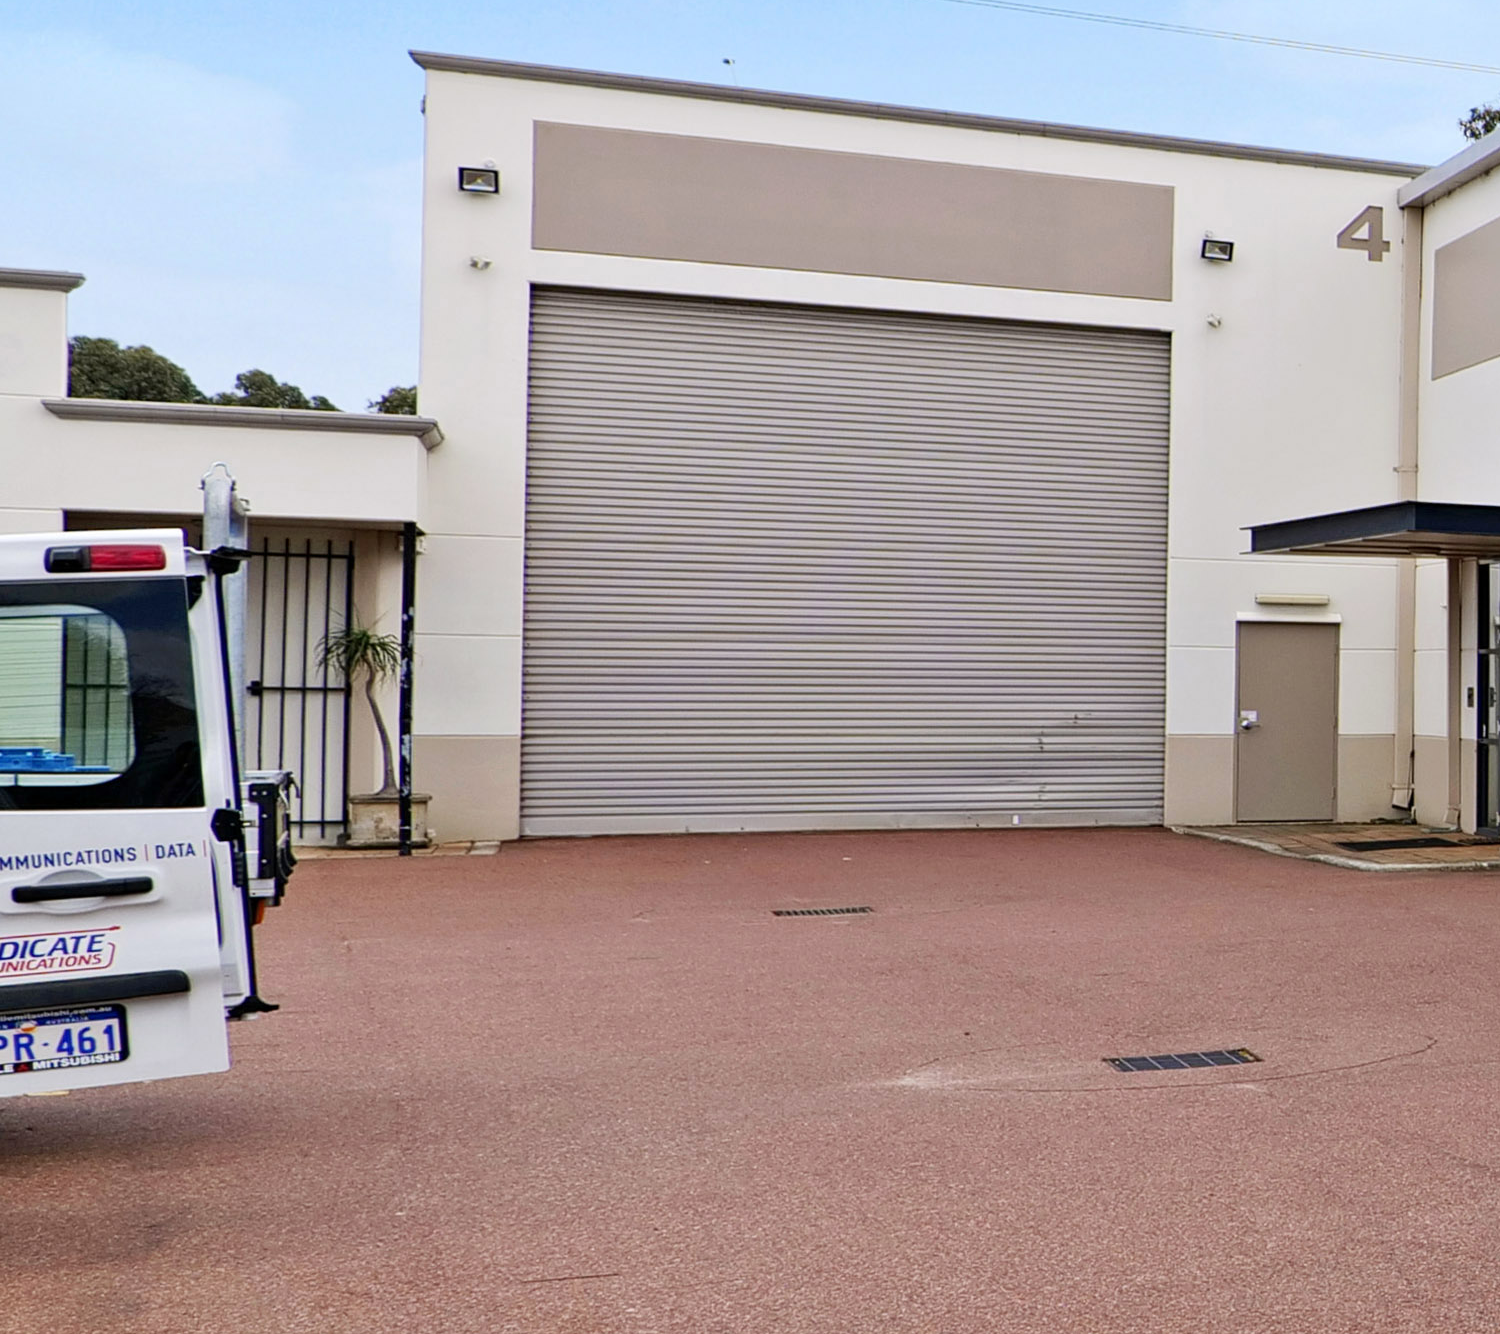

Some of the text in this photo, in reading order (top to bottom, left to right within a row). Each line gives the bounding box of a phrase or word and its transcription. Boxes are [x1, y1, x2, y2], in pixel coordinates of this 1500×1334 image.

[1337, 205, 1390, 262] 4
[155, 842, 196, 859] DATA
[0, 933, 106, 961] DICATE
[32, 1053, 120, 1070] MITSUBISHI
